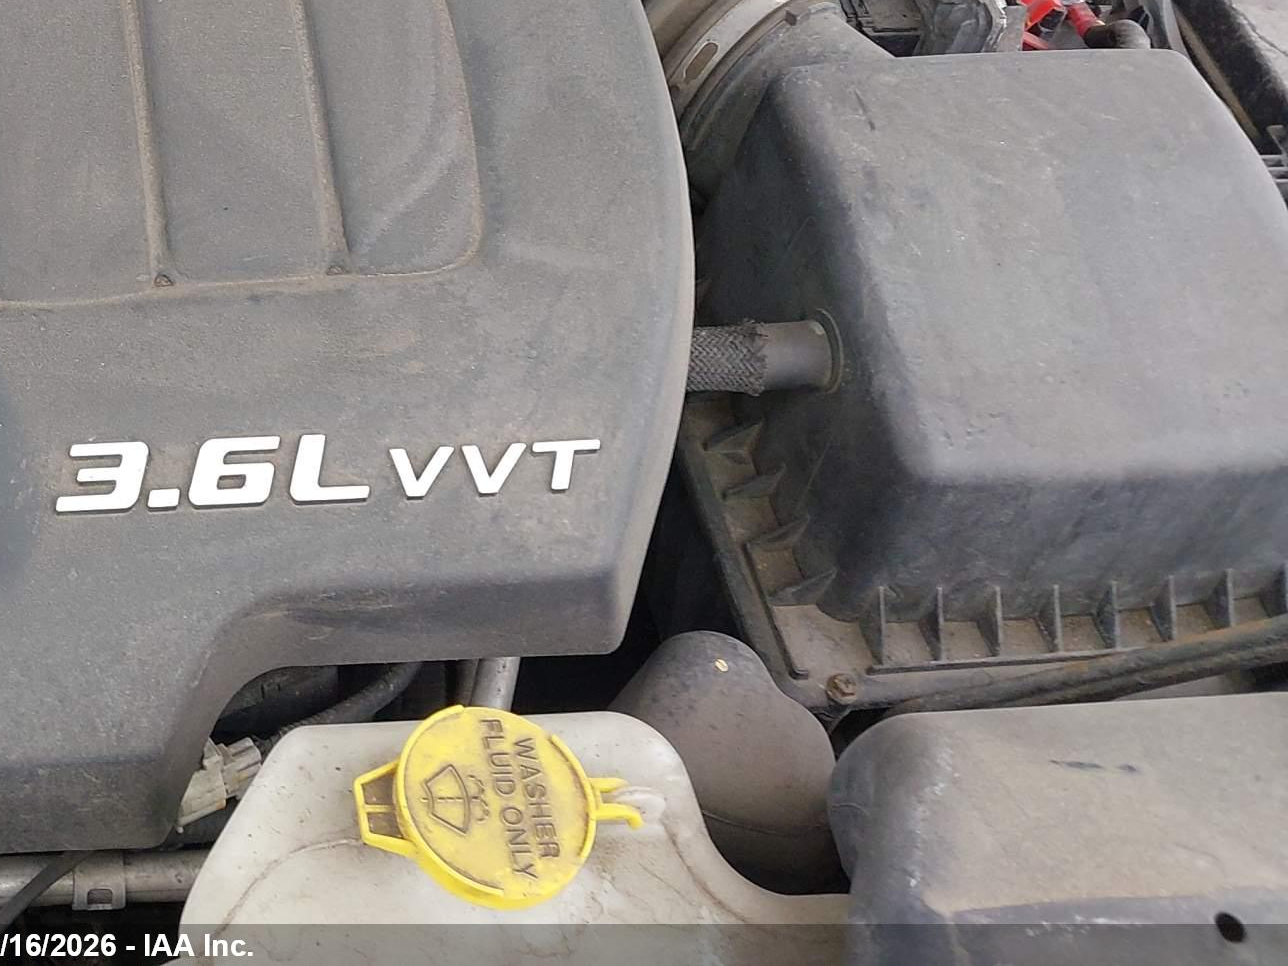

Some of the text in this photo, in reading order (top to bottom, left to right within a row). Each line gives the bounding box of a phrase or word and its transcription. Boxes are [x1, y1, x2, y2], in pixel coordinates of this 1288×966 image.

[55, 434, 602, 515] 3.6L VVT
[478, 718, 538, 879] FLUID ONLY
[512, 737, 560, 859] WASHER
